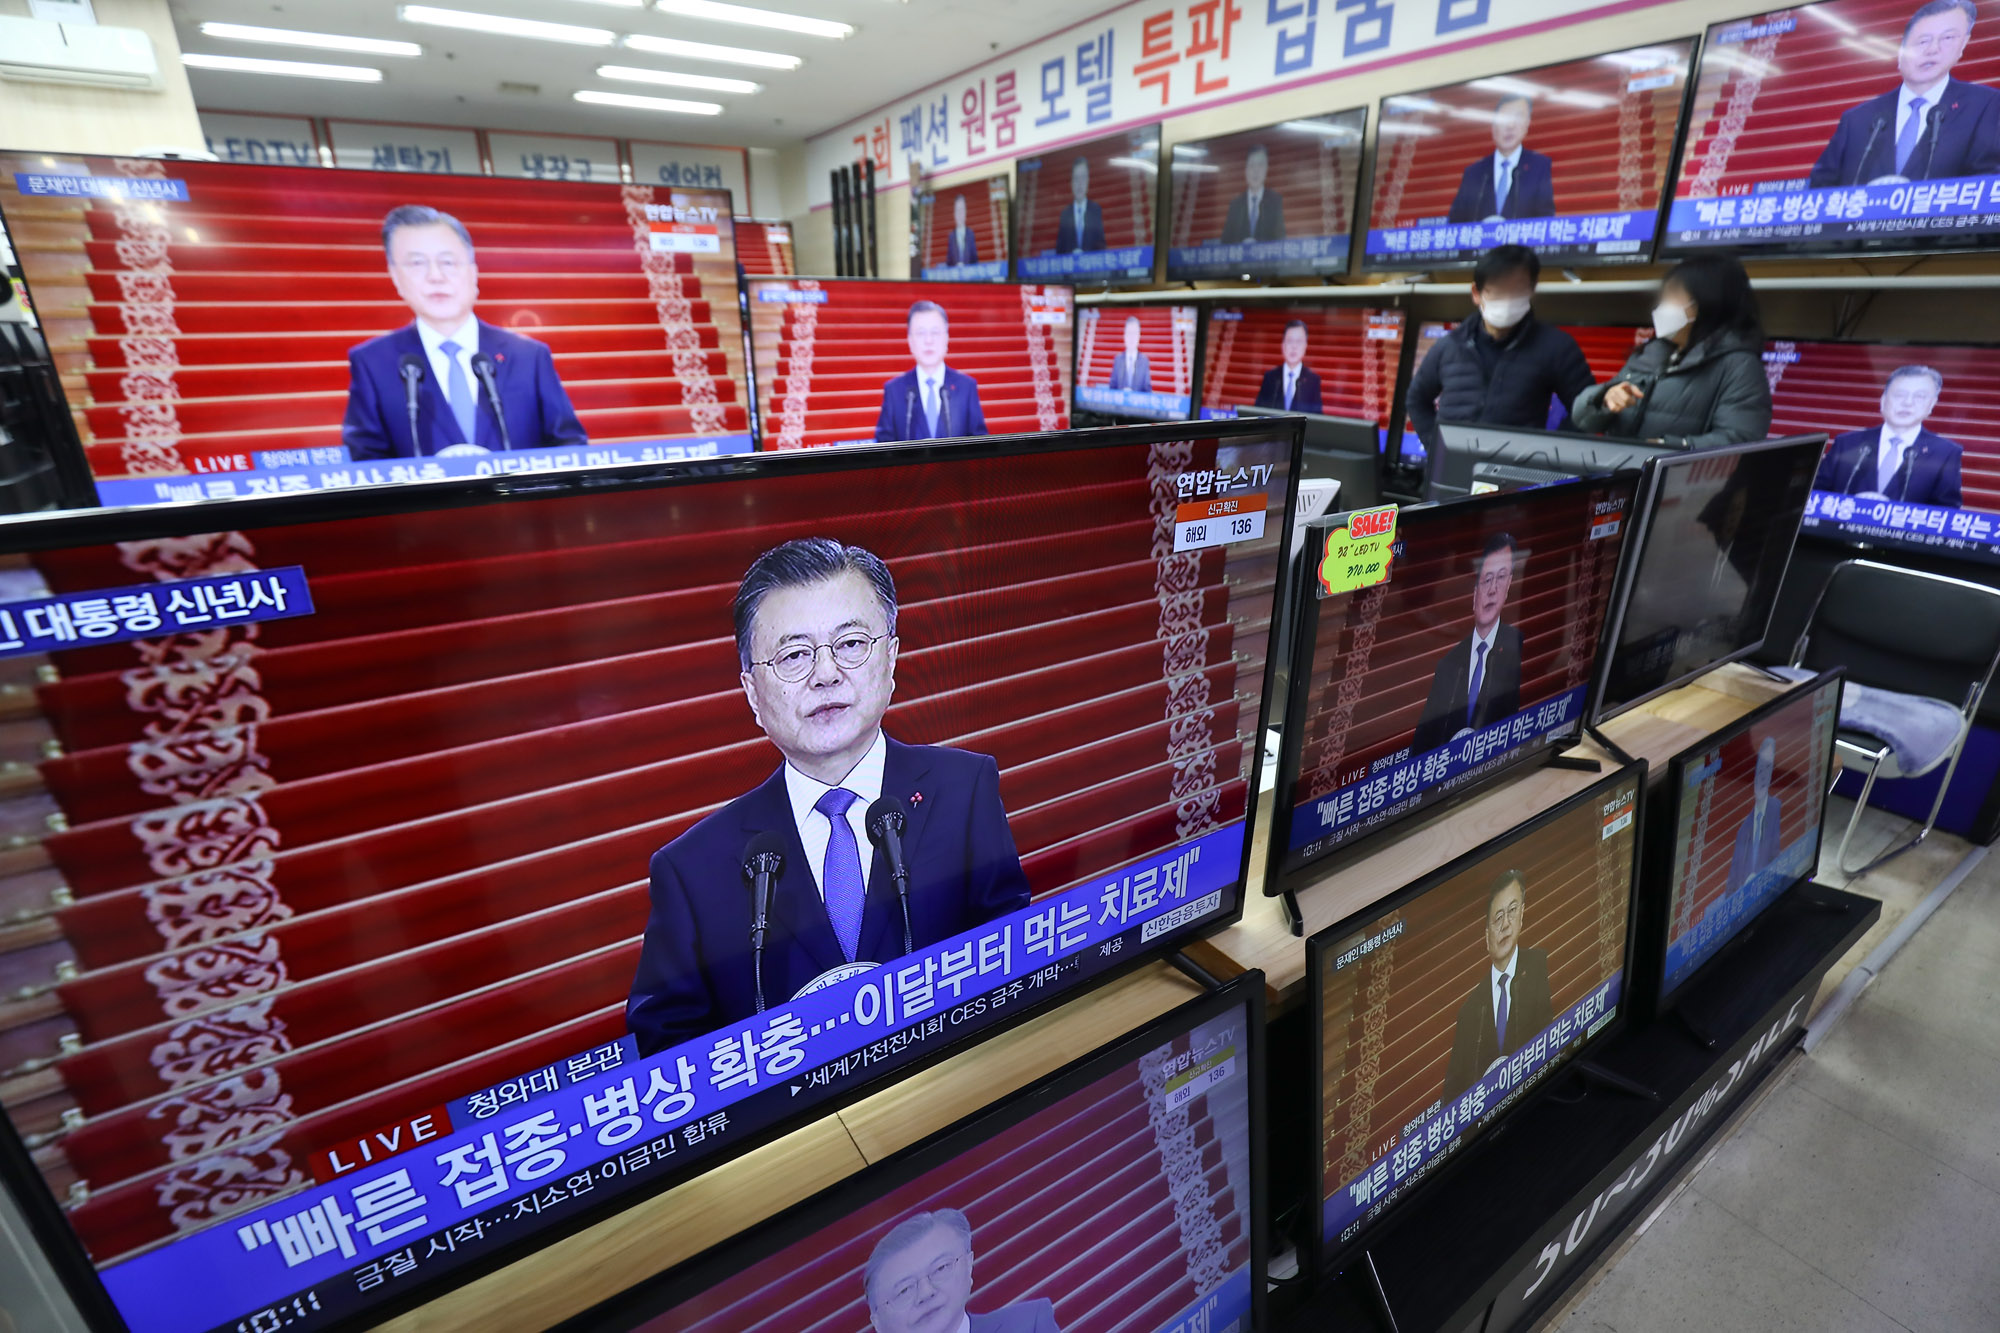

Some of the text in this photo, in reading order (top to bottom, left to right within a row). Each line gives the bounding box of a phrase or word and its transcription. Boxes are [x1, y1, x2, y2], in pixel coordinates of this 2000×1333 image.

[961, 69, 1022, 157] 원룸
[1035, 28, 1114, 127] 모텔
[1133, 0, 1242, 106] 특판
[1721, 183, 1750, 197] LIVE
[194, 453, 249, 474] LIVE
[1176, 463, 1275, 498] 연합뉴스TV
[1207, 500, 1239, 516] 신규확진
[1351, 510, 1396, 538] SALE!
[1951, 512, 1992, 540] 먹는
[1185, 518, 1252, 543] 해외 136
[23, 591, 162, 642] 대통령
[166, 576, 288, 626] 신년사
[1317, 790, 1355, 828] "빠른
[1512, 712, 1535, 743] 먹는
[1535, 692, 1573, 732] 치료제"
[1341, 766, 1366, 786] LIVE
[1372, 747, 1410, 774] 청와대 본관
[1303, 840, 1322, 858] 10:11
[1098, 892, 1221, 959] 제공 신한금융투자
[1336, 921, 1403, 970] 문재인 대통령 신년사
[236, 1166, 429, 1269] "빠른
[435, 1055, 697, 1209] 접종·병상
[1023, 901, 1092, 961] 먹는
[1096, 845, 1202, 928] 치료제"
[682, 1111, 731, 1147] 합류
[804, 1012, 949, 1089] '세계가전전시회'
[949, 997, 988, 1027] CES
[990, 985, 1026, 1011] 금주
[1162, 1025, 1236, 1080] 연합뉴스TV
[466, 1041, 624, 1120] 청와대 본관
[1174, 1065, 1225, 1104] 해외 136
[1349, 1160, 1389, 1208] "빠른
[1549, 1018, 1572, 1050] 먹는
[1572, 981, 1610, 1031] 치료제"
[1402, 1099, 1442, 1138] 청와대 본관
[328, 1113, 438, 1175] LIVE
[1372, 1134, 1397, 1162] LIVE
[1341, 1219, 1360, 1243] 10:11
